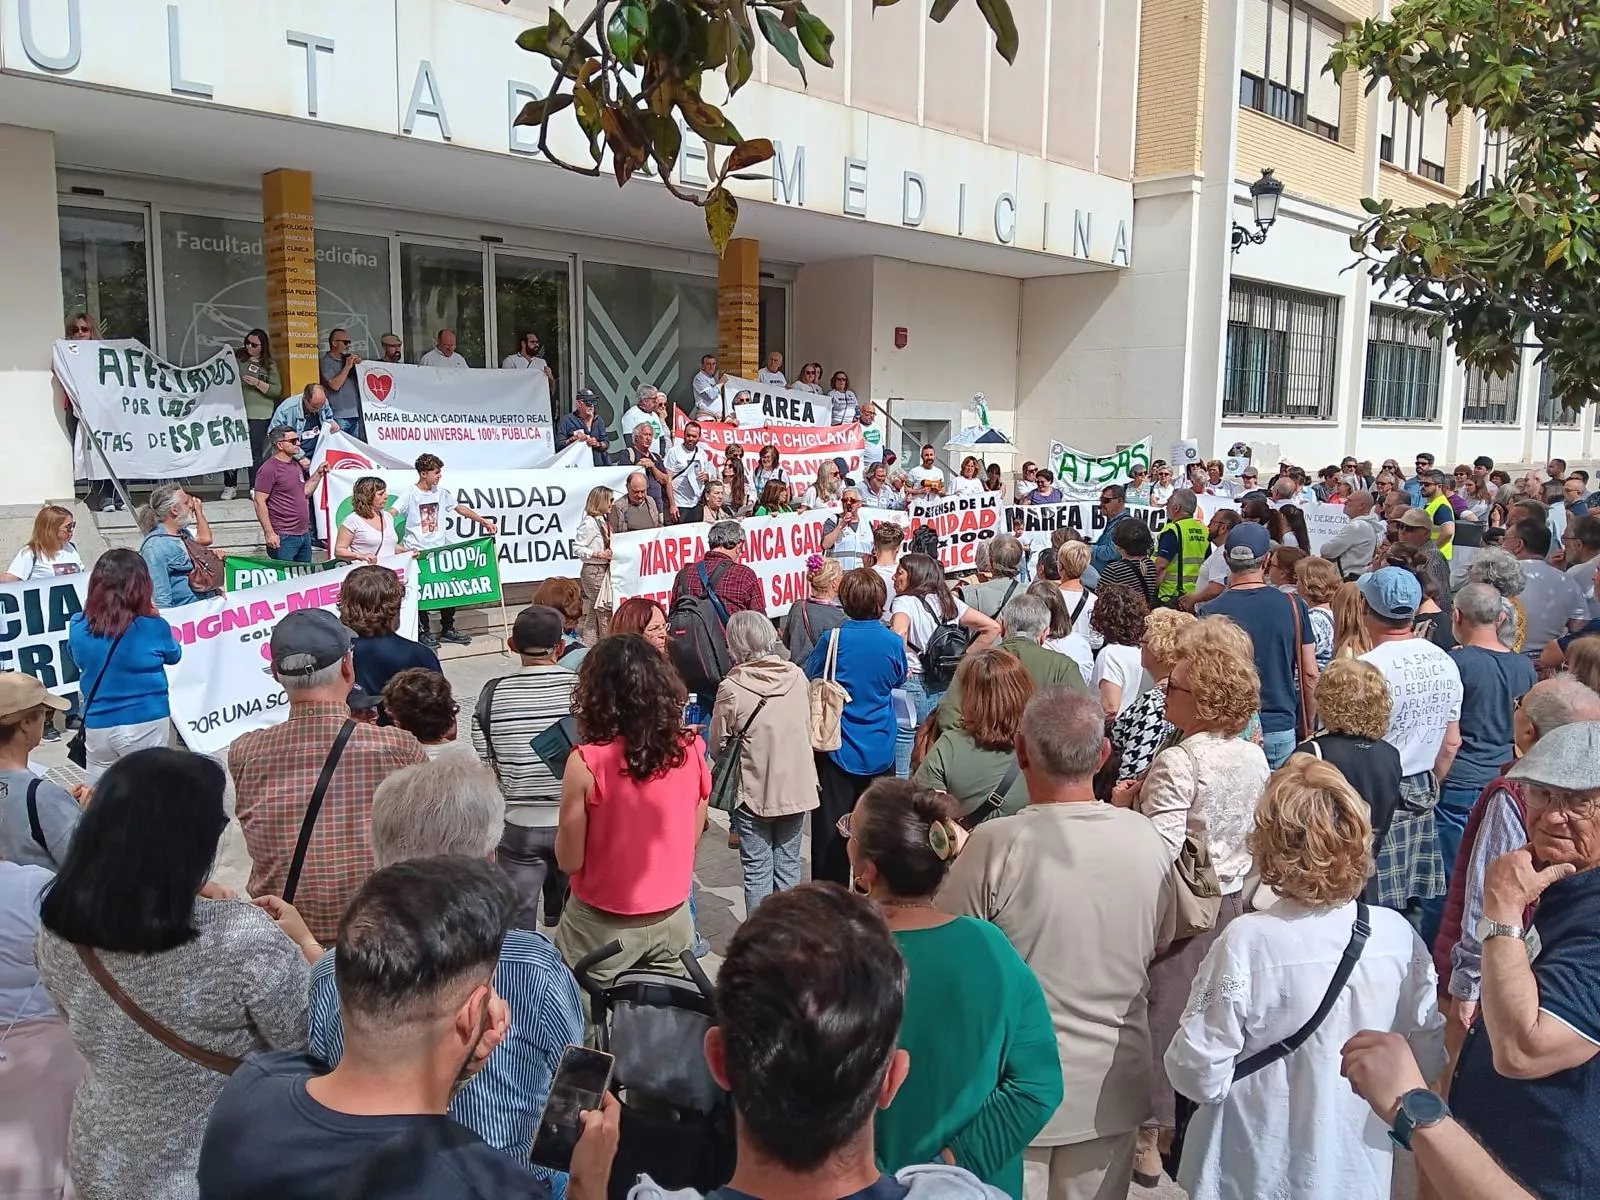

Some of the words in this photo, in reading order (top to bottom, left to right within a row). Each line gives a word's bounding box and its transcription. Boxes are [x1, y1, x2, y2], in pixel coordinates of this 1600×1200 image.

[772, 139, 1131, 264] MEDICINA
[176, 230, 264, 256] Facultad
[315, 246, 379, 269] edicina
[98, 347, 236, 393] AFECTADOS
[122, 396, 151, 415] POR
[364, 412, 400, 422] MAREA
[401, 413, 439, 424] BLANCA
[440, 414, 488, 424] GADITANA
[489, 414, 525, 424] PUERTO
[526, 414, 549, 423] REAL
[148, 432, 167, 449] DE
[377, 426, 422, 441] SANIDAD
[424, 426, 476, 441] UNIVERSAL
[477, 426, 501, 441] 100%
[723, 429, 780, 448] BLANCA
[782, 427, 858, 448] CHICLANA
[1057, 443, 1149, 483] ATSAS
[457, 485, 567, 510] ANIDAD
[913, 500, 956, 518] DEFENSA
[959, 498, 976, 511] DE
[980, 496, 997, 508] LA
[1004, 504, 1083, 533] MAREA
[639, 534, 705, 577] MAREA
[790, 521, 824, 557] GAD
[950, 529, 995, 545] 100
[426, 546, 487, 574] 100%
[234, 568, 278, 590] POR
[222, 698, 263, 723] UNA
[265, 690, 290, 710] SO
